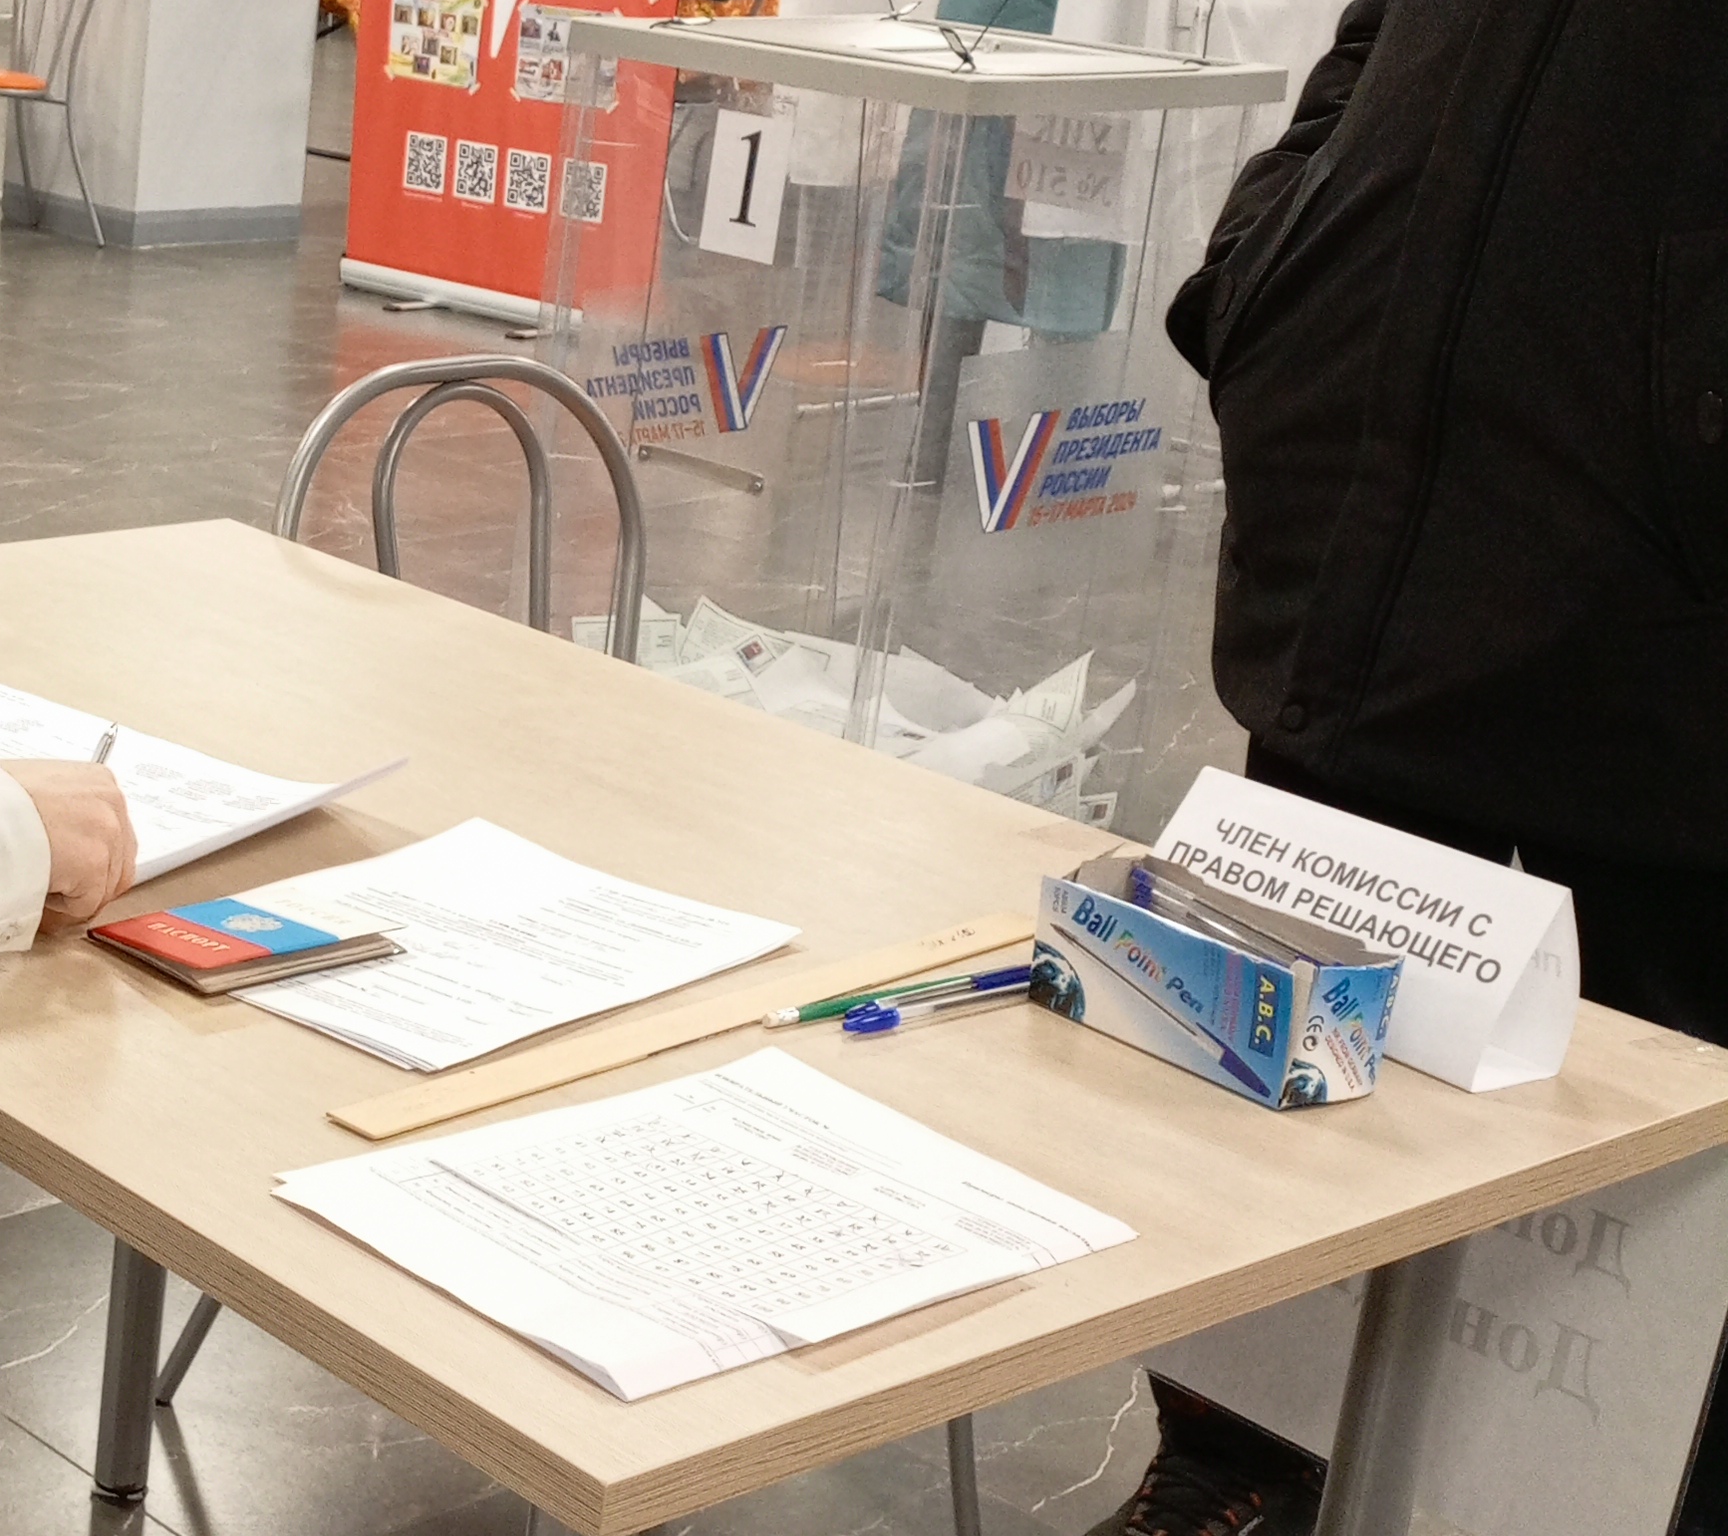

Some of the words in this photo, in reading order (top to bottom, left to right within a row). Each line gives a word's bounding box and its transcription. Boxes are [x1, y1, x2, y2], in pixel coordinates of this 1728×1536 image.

[729, 130, 762, 227] 1
[1066, 398, 1146, 431] ВЫБОРЫ
[1053, 428, 1161, 464] ПРЕЗИДЕНТА
[1038, 465, 1112, 498] РОССИИ
[1216, 817, 1293, 863] ЧЛЕН
[1291, 851, 1465, 928] КОМИССИИ
[1467, 913, 1493, 938] С
[146, 921, 232, 952] ПАСПОРТ
[1167, 840, 1294, 904] ПРАВОМ
[1291, 887, 1502, 985] РЕШАЮЩЕГО
[1071, 895, 1117, 942] Ball
[1114, 930, 1168, 983] Point
[1166, 976, 1204, 1014] Pen
[1254, 974, 1275, 1044] A.B.C.
[1322, 977, 1360, 1022] Ball
